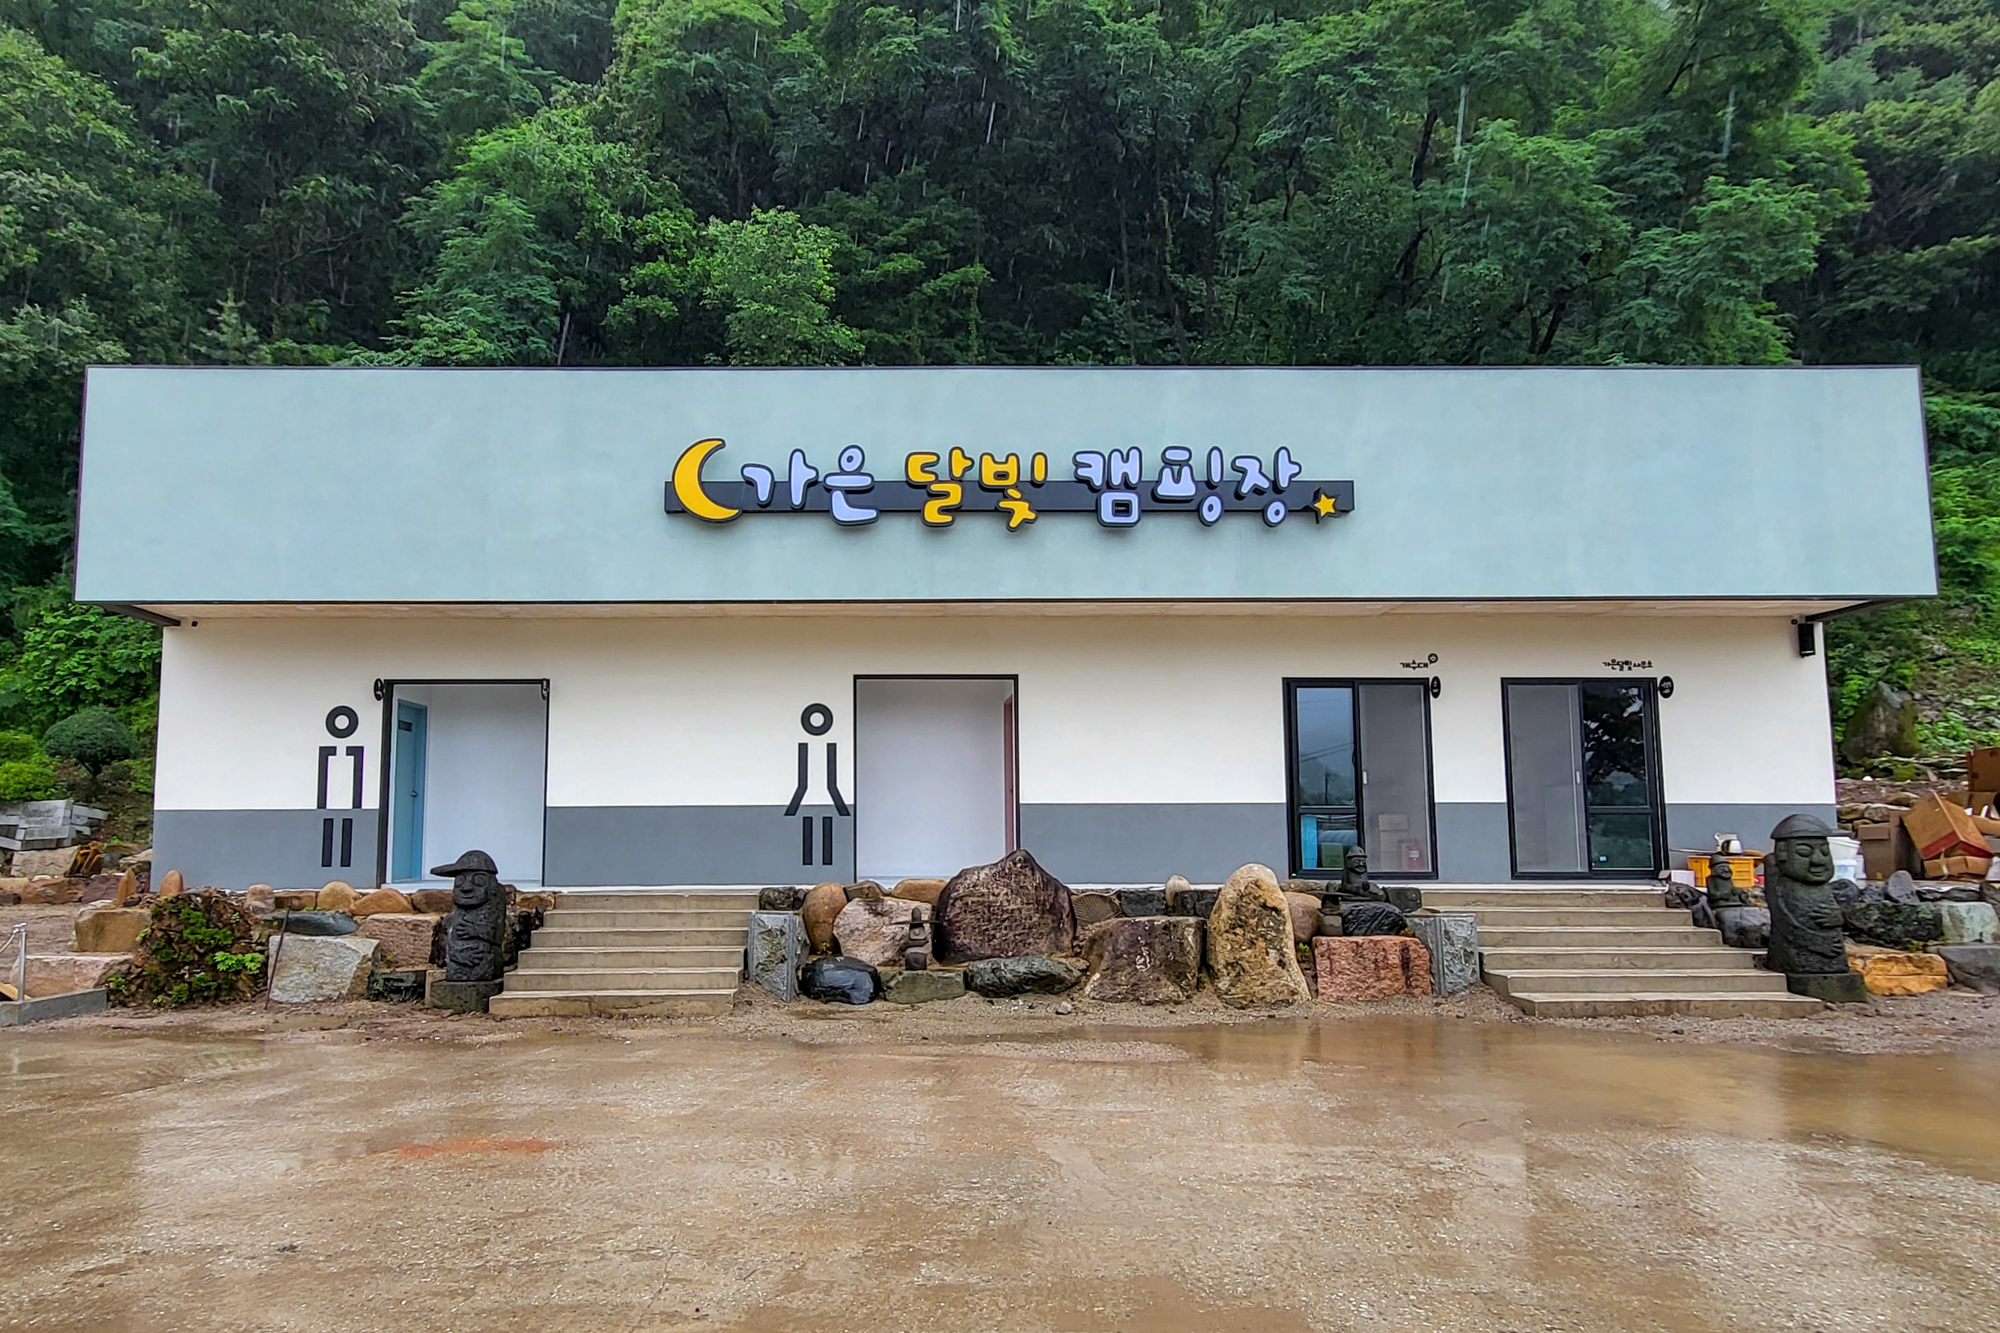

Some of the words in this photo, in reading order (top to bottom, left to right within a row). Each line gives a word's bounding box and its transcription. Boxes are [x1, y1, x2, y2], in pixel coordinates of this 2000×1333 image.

[741, 445, 878, 525] 가은
[904, 446, 1048, 531] 달빛
[1072, 446, 1302, 528] 캠핑장
